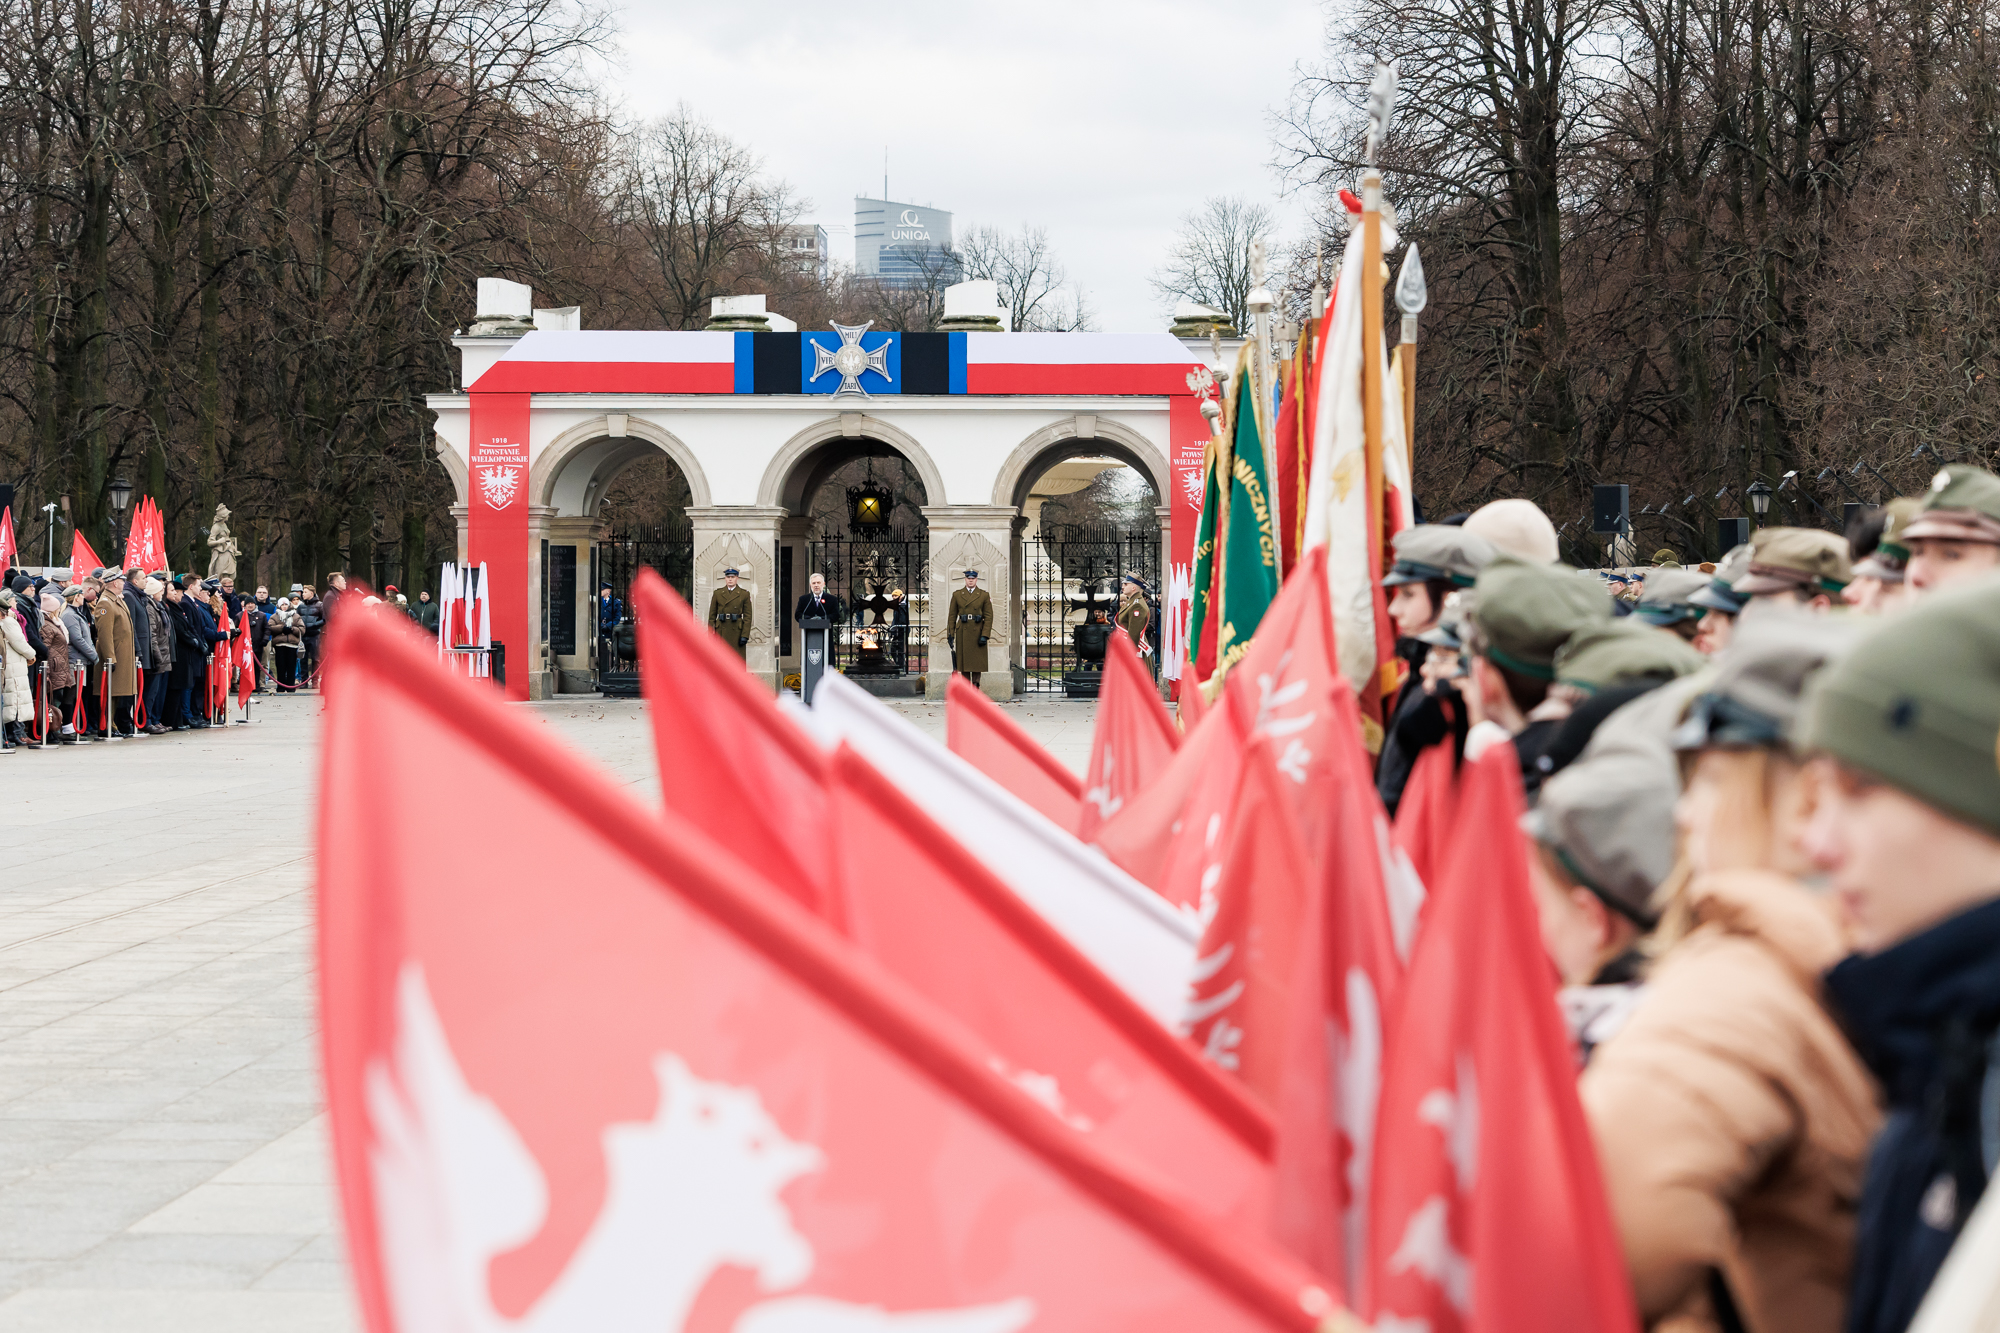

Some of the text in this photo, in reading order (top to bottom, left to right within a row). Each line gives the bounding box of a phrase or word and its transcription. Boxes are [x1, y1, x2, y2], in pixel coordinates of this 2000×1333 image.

[891, 230, 931, 241] UNIQA
[471, 455, 528, 463] WIELKOPOLSKIE
[1234, 454, 1274, 567] NICZNYCH
